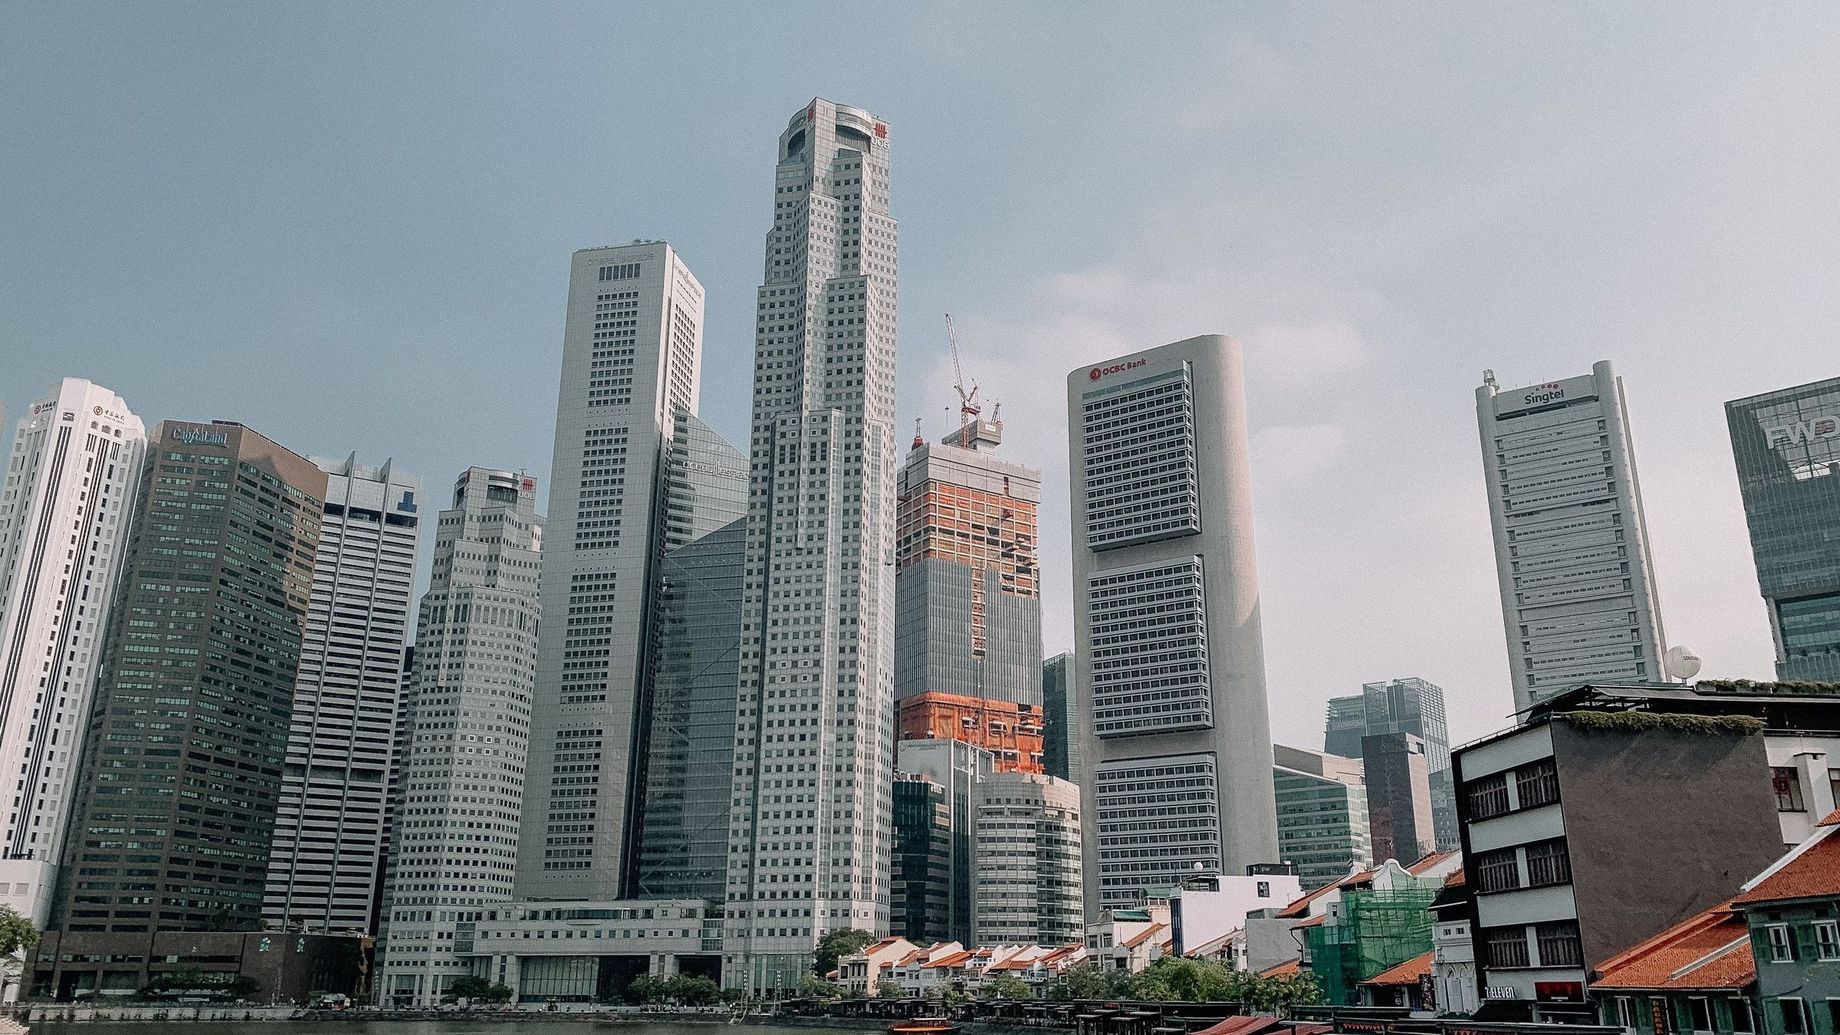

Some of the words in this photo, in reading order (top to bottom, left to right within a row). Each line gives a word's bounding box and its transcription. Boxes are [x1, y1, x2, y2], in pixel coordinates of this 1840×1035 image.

[1102, 363, 1126, 375] OCBC
[1127, 358, 1147, 370] Bank
[1524, 389, 1565, 404] Singtel
[1764, 415, 1840, 450] FWD
